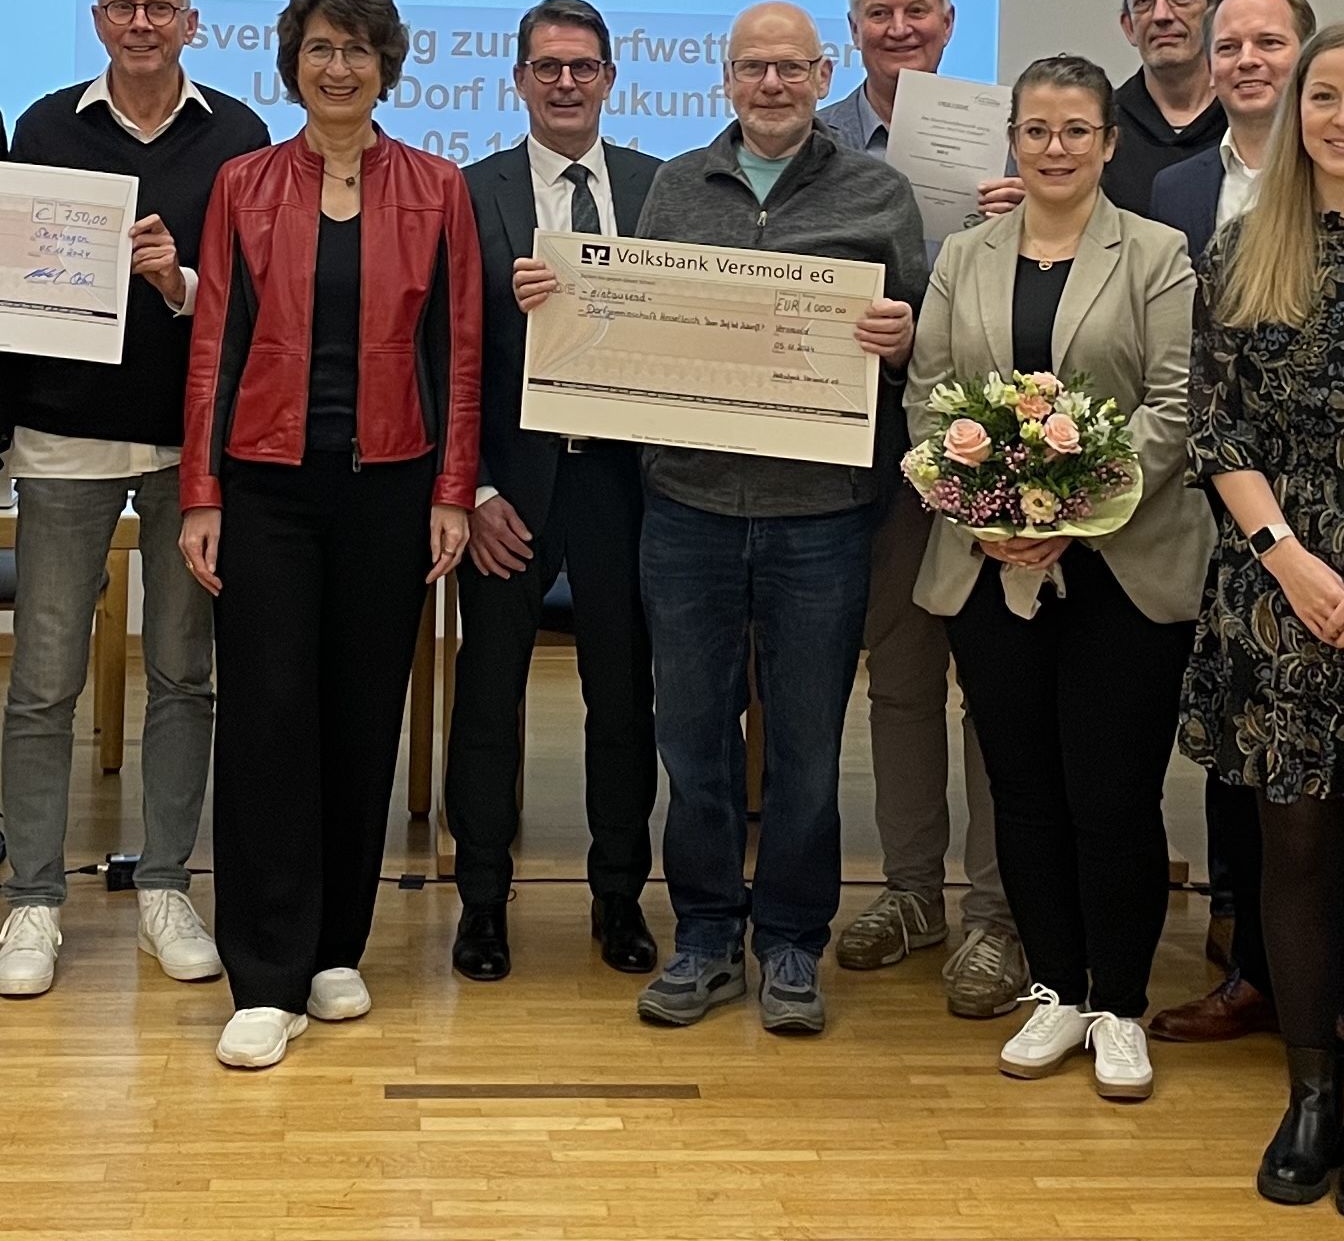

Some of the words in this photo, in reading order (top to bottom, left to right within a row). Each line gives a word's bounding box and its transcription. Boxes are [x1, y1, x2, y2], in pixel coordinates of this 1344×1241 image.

[393, 75, 485, 110] Dorf
[64, 210, 108, 225] 750,00
[616, 247, 709, 272] Volksbank
[716, 257, 803, 281] Versmold
[809, 269, 835, 284] eG
[776, 298, 799, 312] EUR
